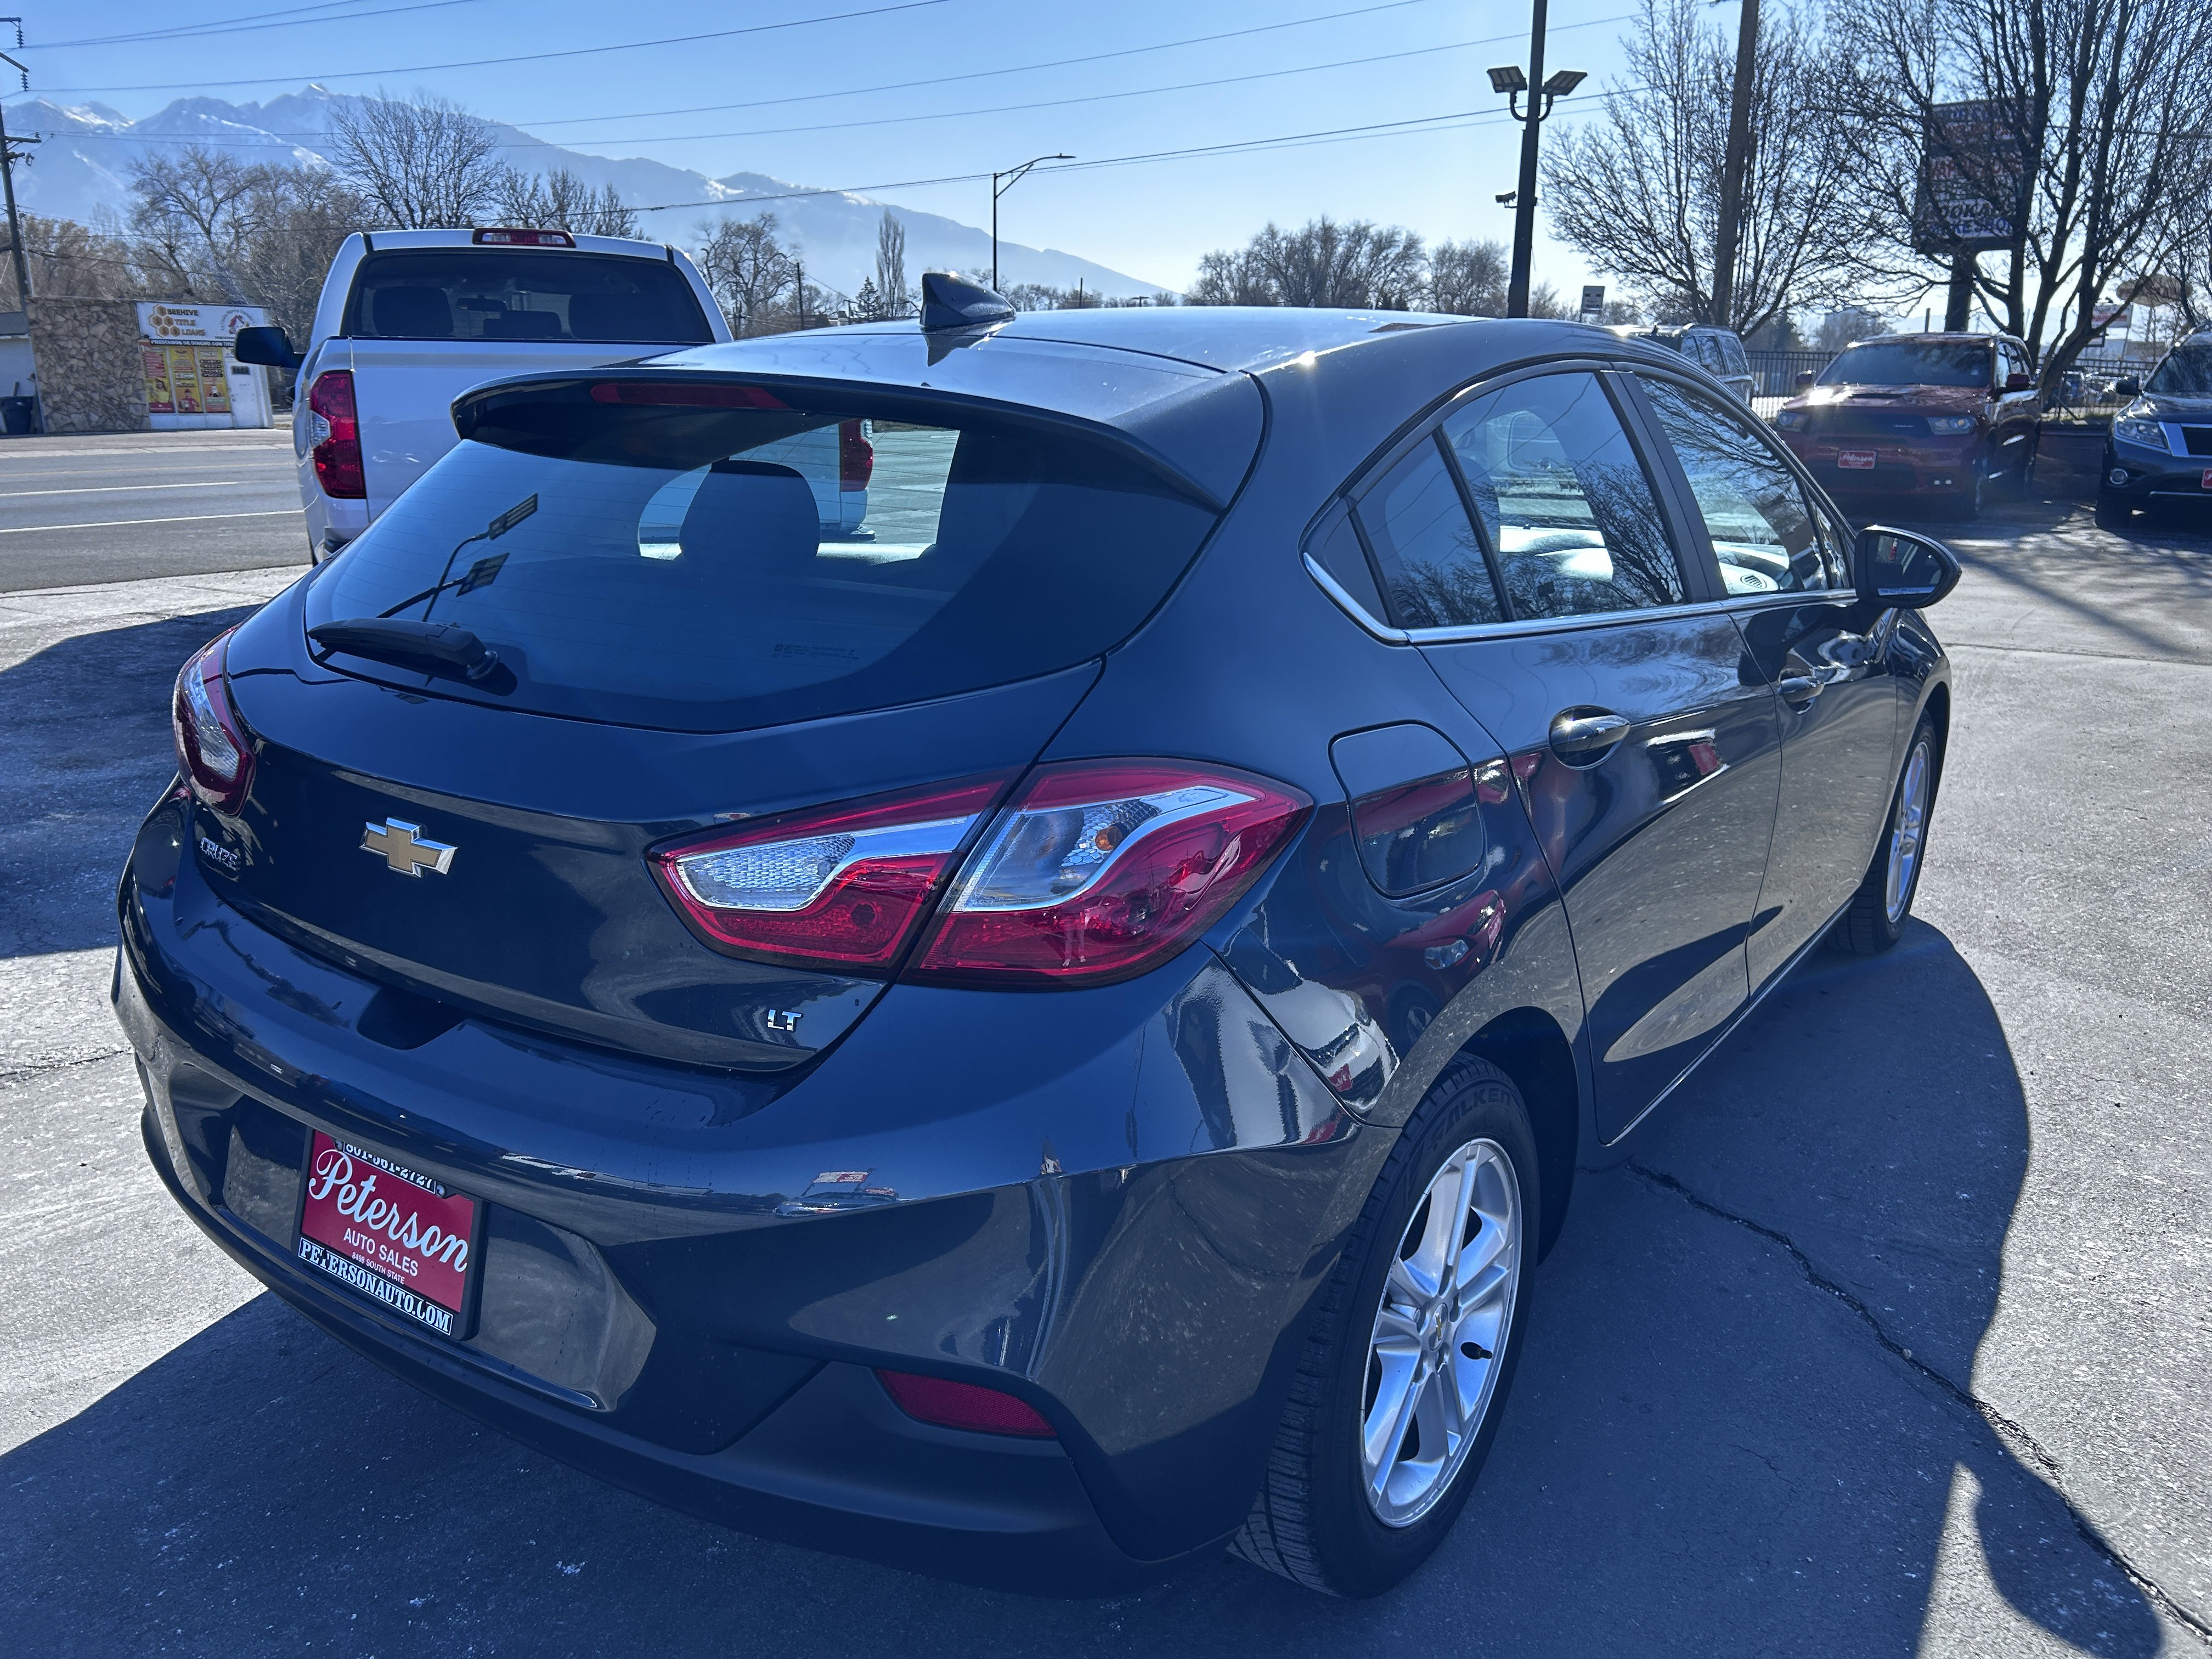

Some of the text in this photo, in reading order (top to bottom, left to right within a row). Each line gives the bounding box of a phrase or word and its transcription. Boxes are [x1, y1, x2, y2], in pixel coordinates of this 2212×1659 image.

[200, 837, 238, 871] CRUZE
[768, 1009, 802, 1031] LT
[308, 1149, 469, 1273] Peterson
[343, 1227, 419, 1277] AUTO SALES
[366, 1258, 386, 1275] SOUTH
[387, 1269, 405, 1285] STATE
